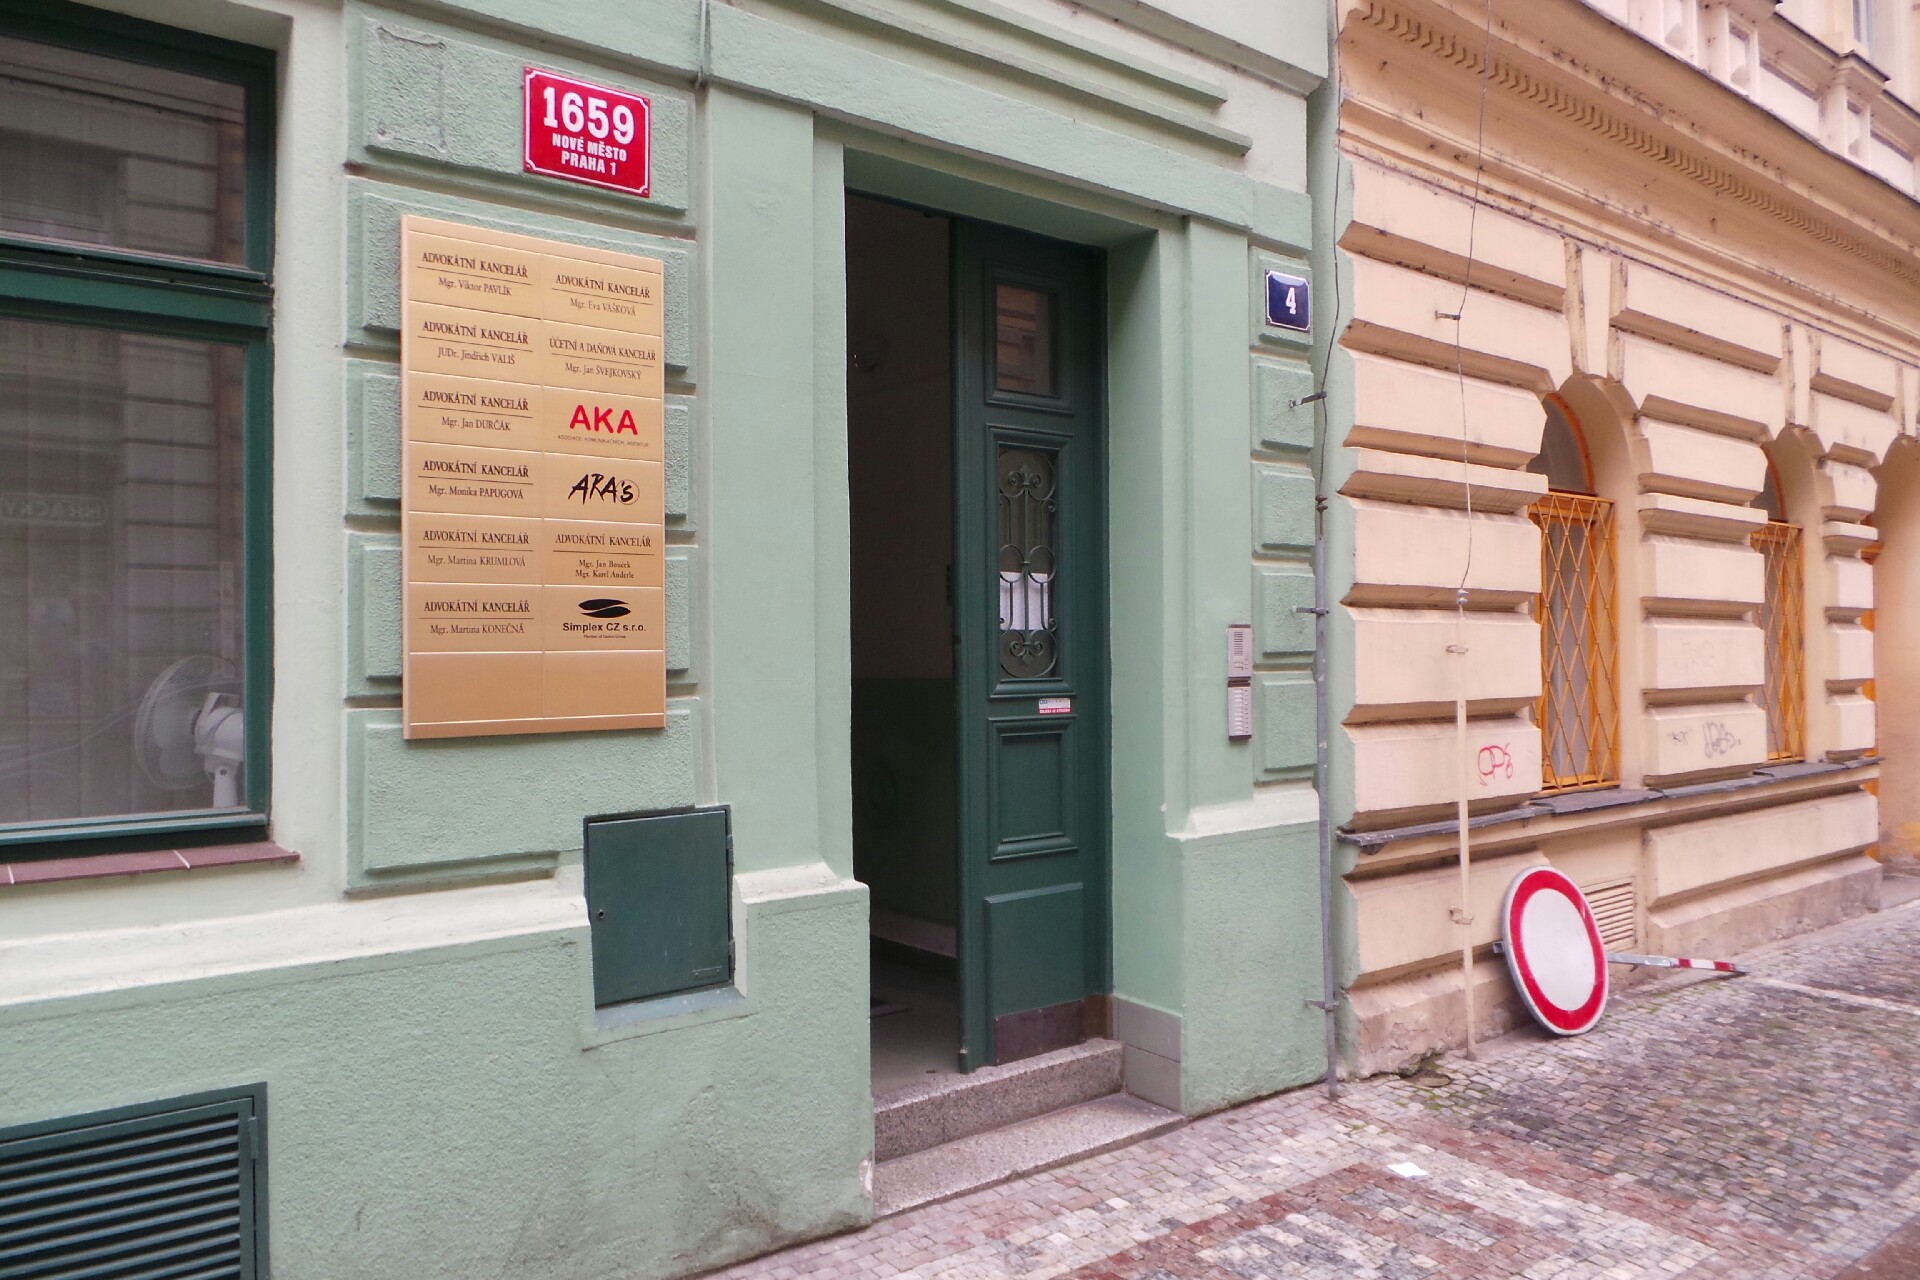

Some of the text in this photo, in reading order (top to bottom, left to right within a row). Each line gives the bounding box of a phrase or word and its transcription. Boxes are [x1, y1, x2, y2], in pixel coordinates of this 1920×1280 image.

[543, 86, 635, 145] 1659
[552, 133, 627, 162] NOVÉ MĚSTO
[561, 151, 617, 176] PRAHA 1
[421, 252, 528, 278] ADVOKÁTNÍ KANCELÁŘ
[438, 277, 512, 296] Mgr. Viktor PAVLÍK
[556, 274, 650, 298] ADVOKÁTNÍ KANCELÁŘ
[570, 298, 636, 316] Mgr. Eva VAŠKOVÁ
[1285, 287, 1297, 315] 4
[422, 321, 529, 345] ADVOKÁTNÍ KANCELÁŘ
[437, 346, 516, 365] JUDr. Jindřich VALIŠ
[549, 336, 656, 361] ÚČETNÍ A DAŇOVÁ KANCELÁŘ
[565, 362, 642, 380] Mgr. Jan ŠVEJKOVSKÝ
[422, 390, 529, 411] ADVOKÁTNÍ KANCELÁŘ
[441, 416, 511, 431] Mgr. Jan DURČÁK
[569, 404, 639, 436] AKA
[422, 460, 529, 478] ADVOKÁTNÍ KANCELÁŘ
[428, 484, 524, 500] Mgr. Monika PAPUGOVÁ
[423, 529, 529, 545] ADVOKÁTNÍ KANCELÁŘ
[555, 533, 652, 548] ADVOKÁTNÍ KANCELÁŘ
[427, 554, 526, 567] Mgr. Martina KRUMLOVÁ
[578, 559, 594, 570] Mgr.
[595, 560, 607, 569] Jan
[575, 569, 635, 579] Mgr. Karel Anderle
[423, 600, 530, 613] ADVOKÁTNÍ KANCELÁŘ
[430, 623, 525, 636] Mgr. Martina KONEČNÁ
[562, 622, 647, 634] Simplex CZ s.r.o.
